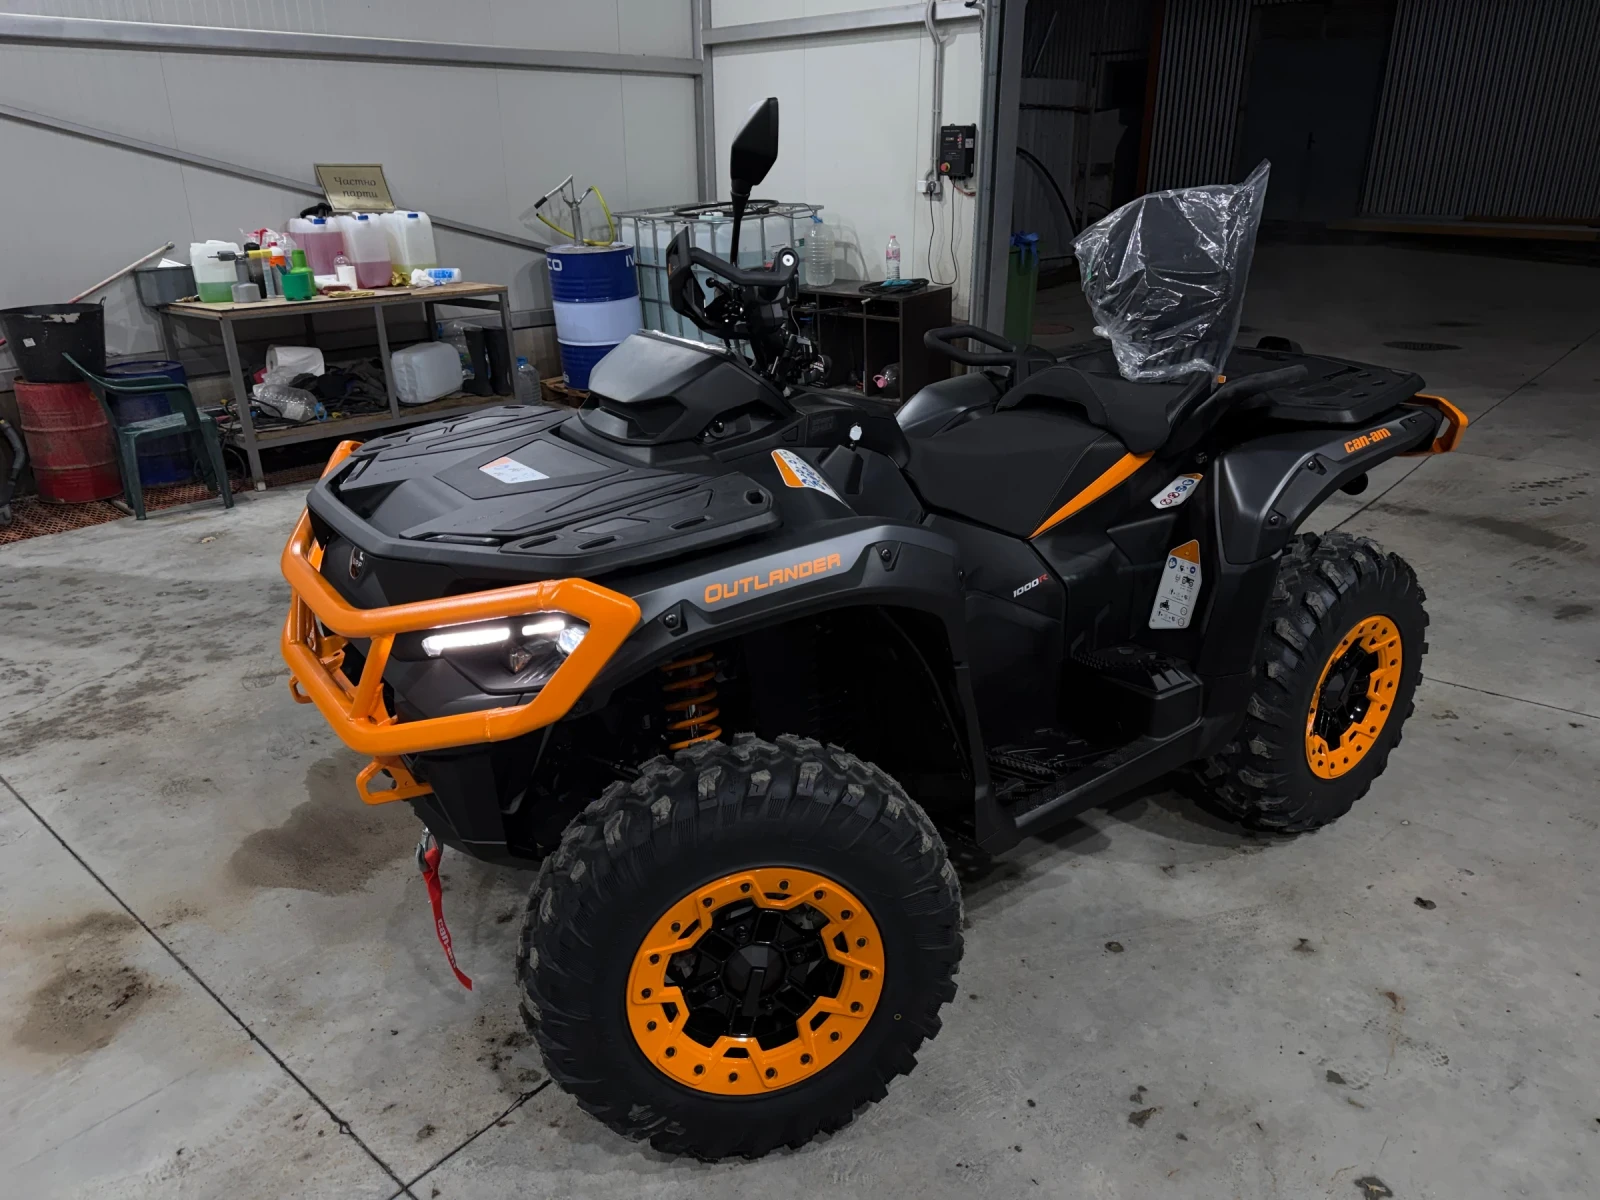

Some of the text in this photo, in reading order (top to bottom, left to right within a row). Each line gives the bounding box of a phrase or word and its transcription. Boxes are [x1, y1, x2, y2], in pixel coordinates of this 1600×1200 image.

[333, 176, 377, 187] Частно
[342, 190, 379, 200] парти
[704, 553, 841, 604] OUTLANDER
[1012, 573, 1049, 599] 1000R
